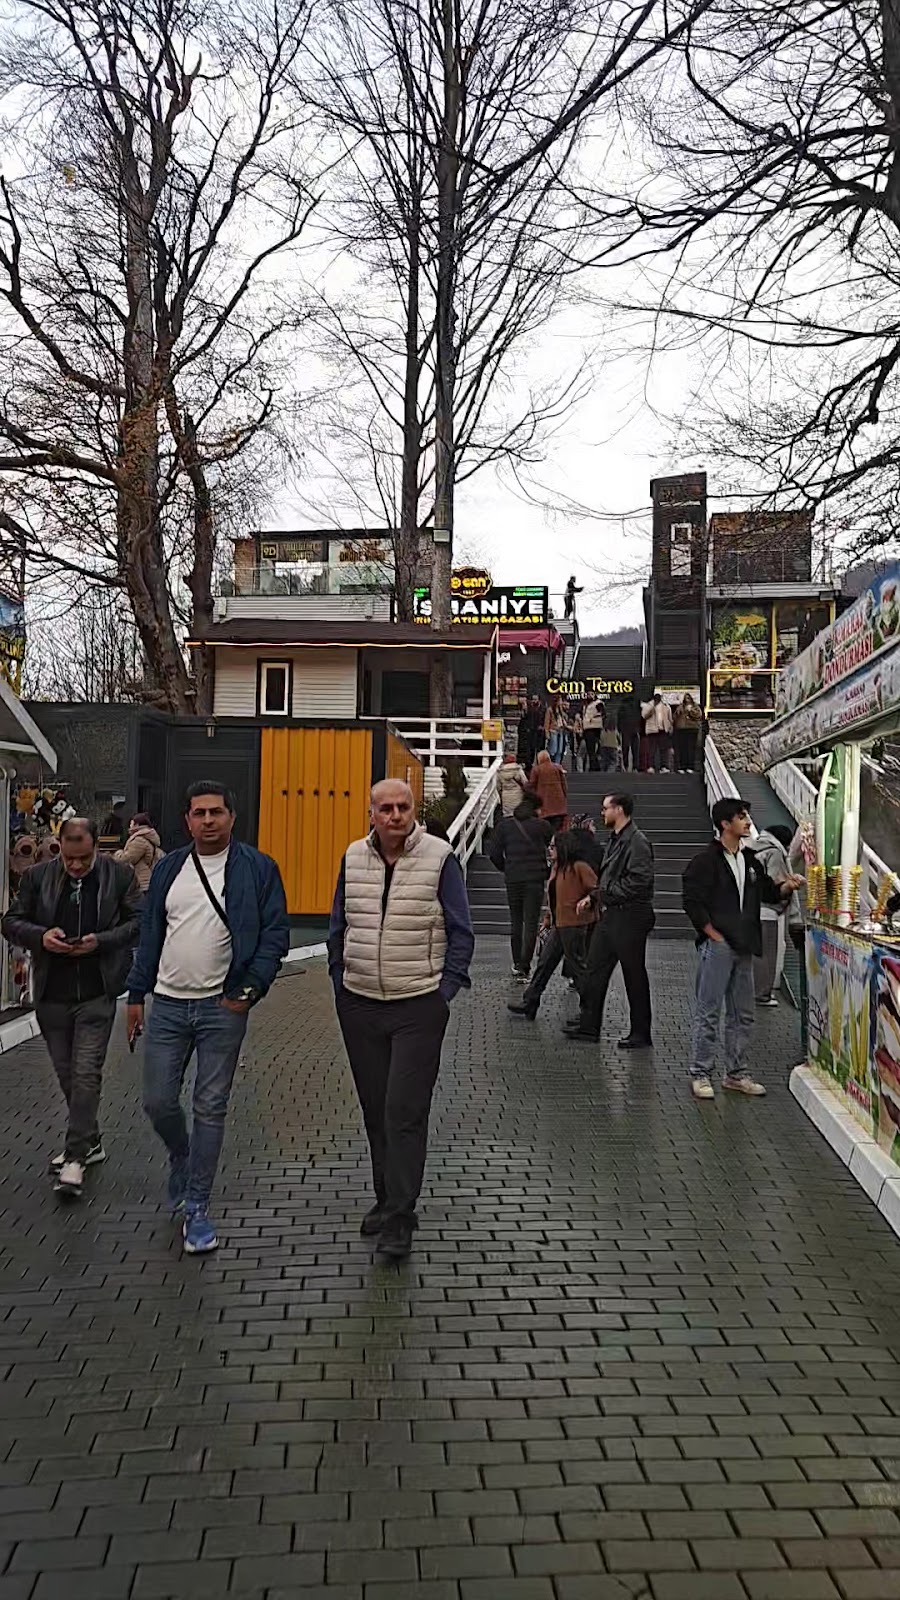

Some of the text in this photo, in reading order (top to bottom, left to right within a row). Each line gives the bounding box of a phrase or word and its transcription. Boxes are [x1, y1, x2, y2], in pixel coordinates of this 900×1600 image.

[451, 615, 544, 624] ATIŞ MAĞAZASI
[546, 676, 634, 694] Cam Teras
